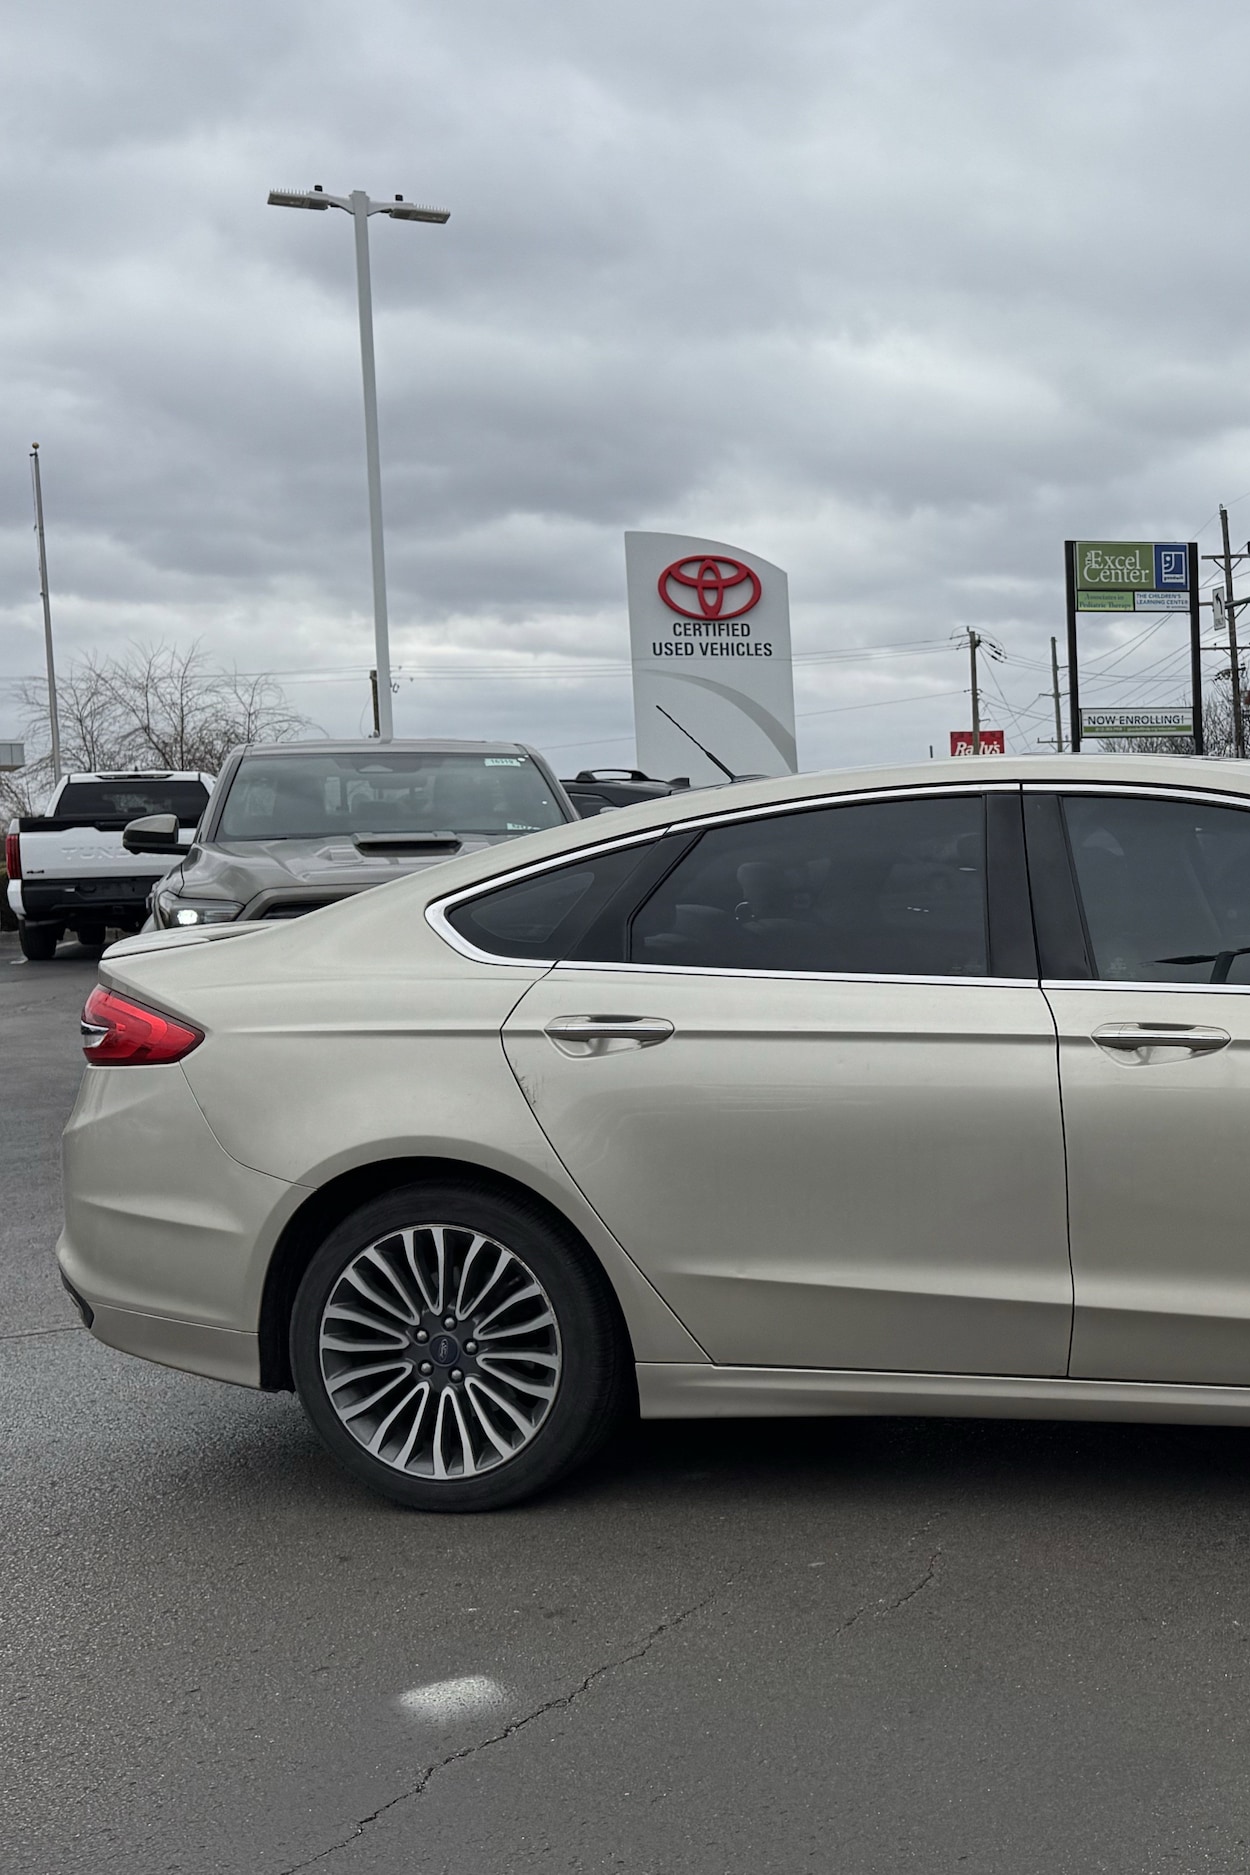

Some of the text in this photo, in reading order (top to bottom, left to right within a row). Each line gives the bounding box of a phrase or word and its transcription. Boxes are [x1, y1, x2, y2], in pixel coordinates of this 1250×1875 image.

[1090, 550, 1141, 569] Excel
[1083, 564, 1149, 583] Center
[672, 622, 751, 637] CERTIFIED
[652, 642, 773, 657] USED VEHICLES
[1087, 715, 1185, 725] NOW ENROLLING!
[955, 740, 1000, 756] Raly's
